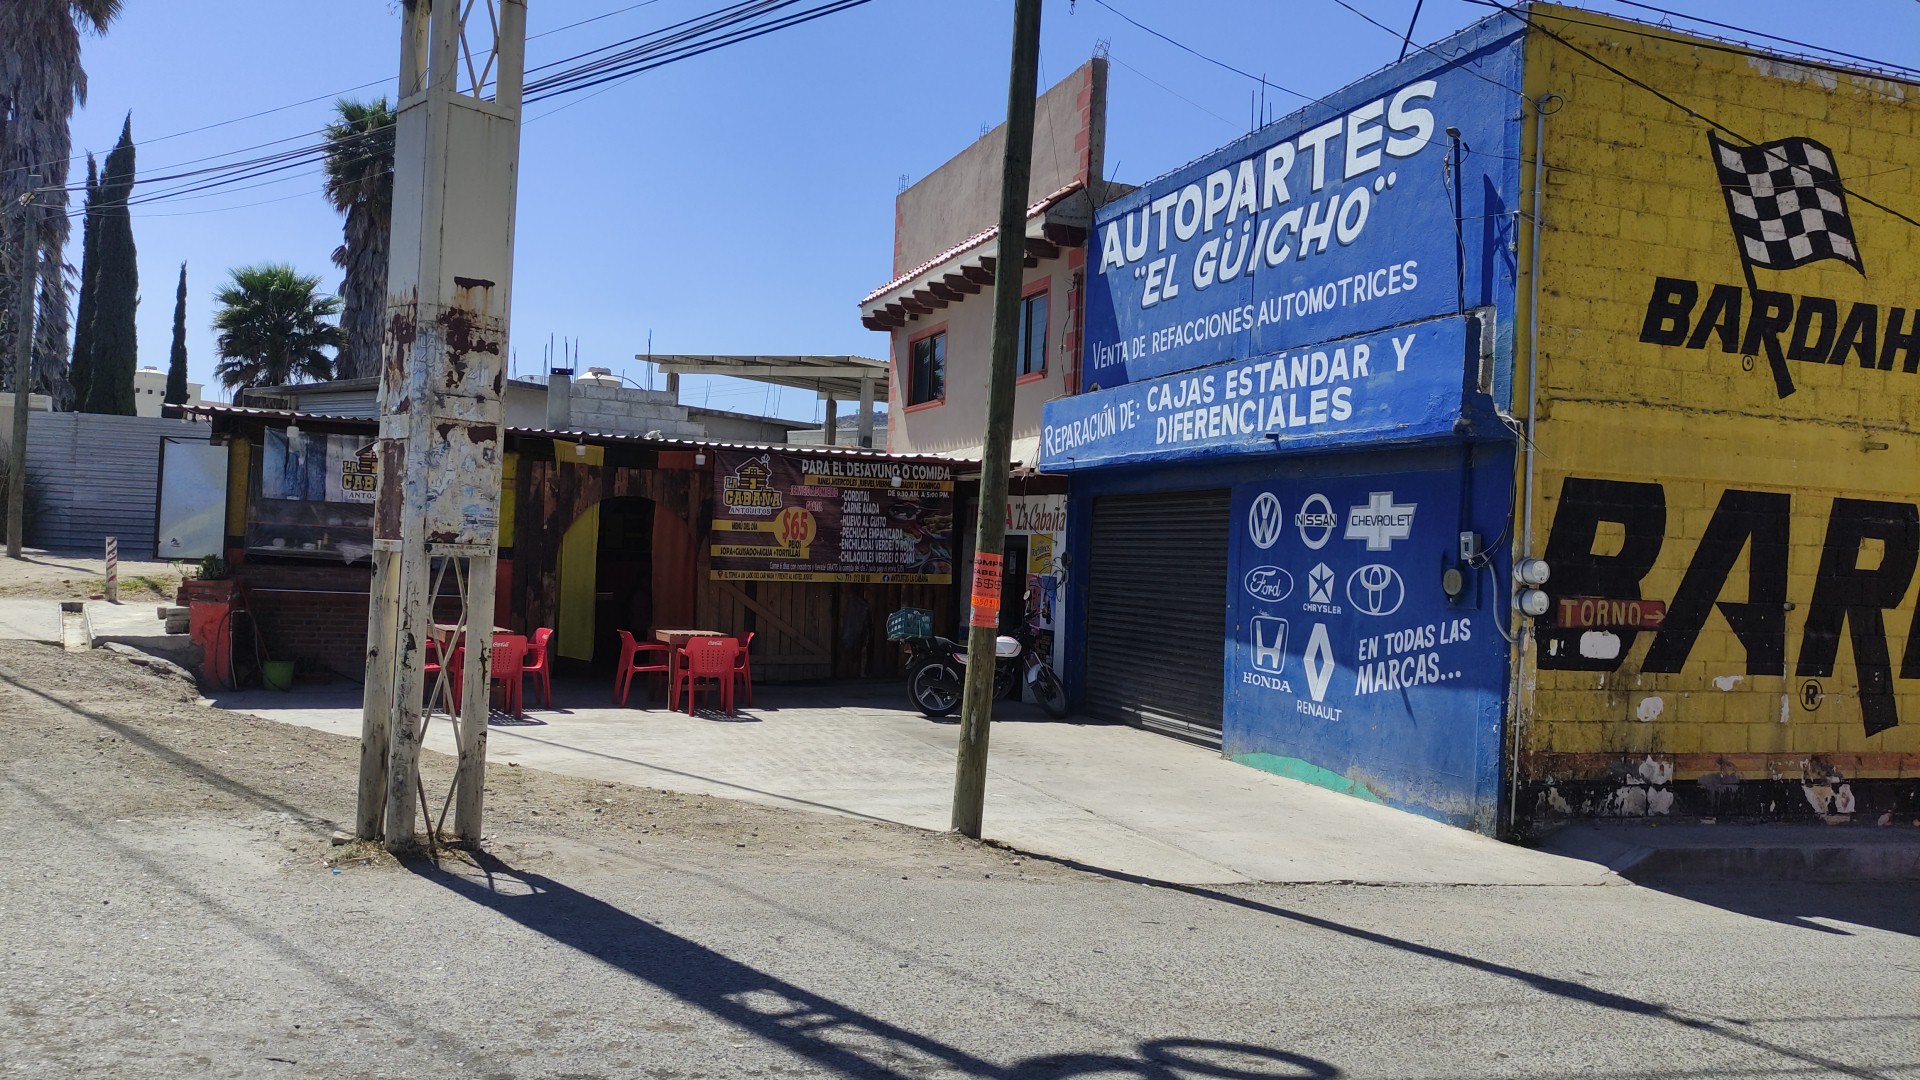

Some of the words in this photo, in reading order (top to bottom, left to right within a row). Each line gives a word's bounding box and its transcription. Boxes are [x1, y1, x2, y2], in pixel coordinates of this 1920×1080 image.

[1098, 80, 1438, 275] AUTOPARTES
[1092, 340, 1129, 370] VENTA
[1132, 335, 1146, 359] DE
[1151, 303, 1254, 355] REFACCIONES
[1257, 260, 1418, 326] AUTOMOTRICES
[1147, 375, 1215, 413] CAJAS
[1225, 343, 1370, 399] ESTÁNDAR
[1391, 333, 1417, 372] Y
[1044, 404, 1117, 458] REPARACIÓN
[1119, 399, 1141, 430] DE:
[1156, 386, 1353, 446] DIFERENCIALES
[343, 460, 359, 474] LA
[801, 459, 830, 475] PARA
[832, 461, 845, 476] EL
[846, 462, 900, 479] DESAYUNO
[902, 464, 910, 479] O
[912, 465, 951, 481] COMIDA
[342, 474, 377, 492] CAB
[725, 476, 739, 489] LA
[725, 488, 782, 507] CABAÑA
[887, 489, 896, 497] DE
[730, 507, 771, 515] ANTOJITOS
[862, 503, 880, 514] ASADA
[1029, 503, 1066, 532] Cabaña
[743, 522, 751, 530] DEL
[783, 509, 808, 542] $65
[862, 516, 869, 527] AL
[869, 516, 887, 527] GUSTO
[1296, 514, 1337, 527] NISSAN
[1351, 513, 1413, 527] CHEVROLET
[868, 527, 904, 539] EMPANIZADA
[875, 540, 894, 550] VERDES
[895, 540, 900, 550] O
[875, 551, 894, 563] VERDES
[895, 552, 899, 562] O
[1250, 569, 1282, 597] Ford
[1302, 603, 1342, 614] CHRYSLER
[1536, 476, 1920, 738] BAR
[1560, 599, 1641, 628] TORNO
[1358, 636, 1379, 661] EN
[1384, 623, 1436, 655] TODAS
[1440, 617, 1472, 643] LAS
[1242, 672, 1293, 693] HONDA
[1354, 652, 1462, 697] MARCAS...
[1297, 699, 1343, 722] RENAULT
